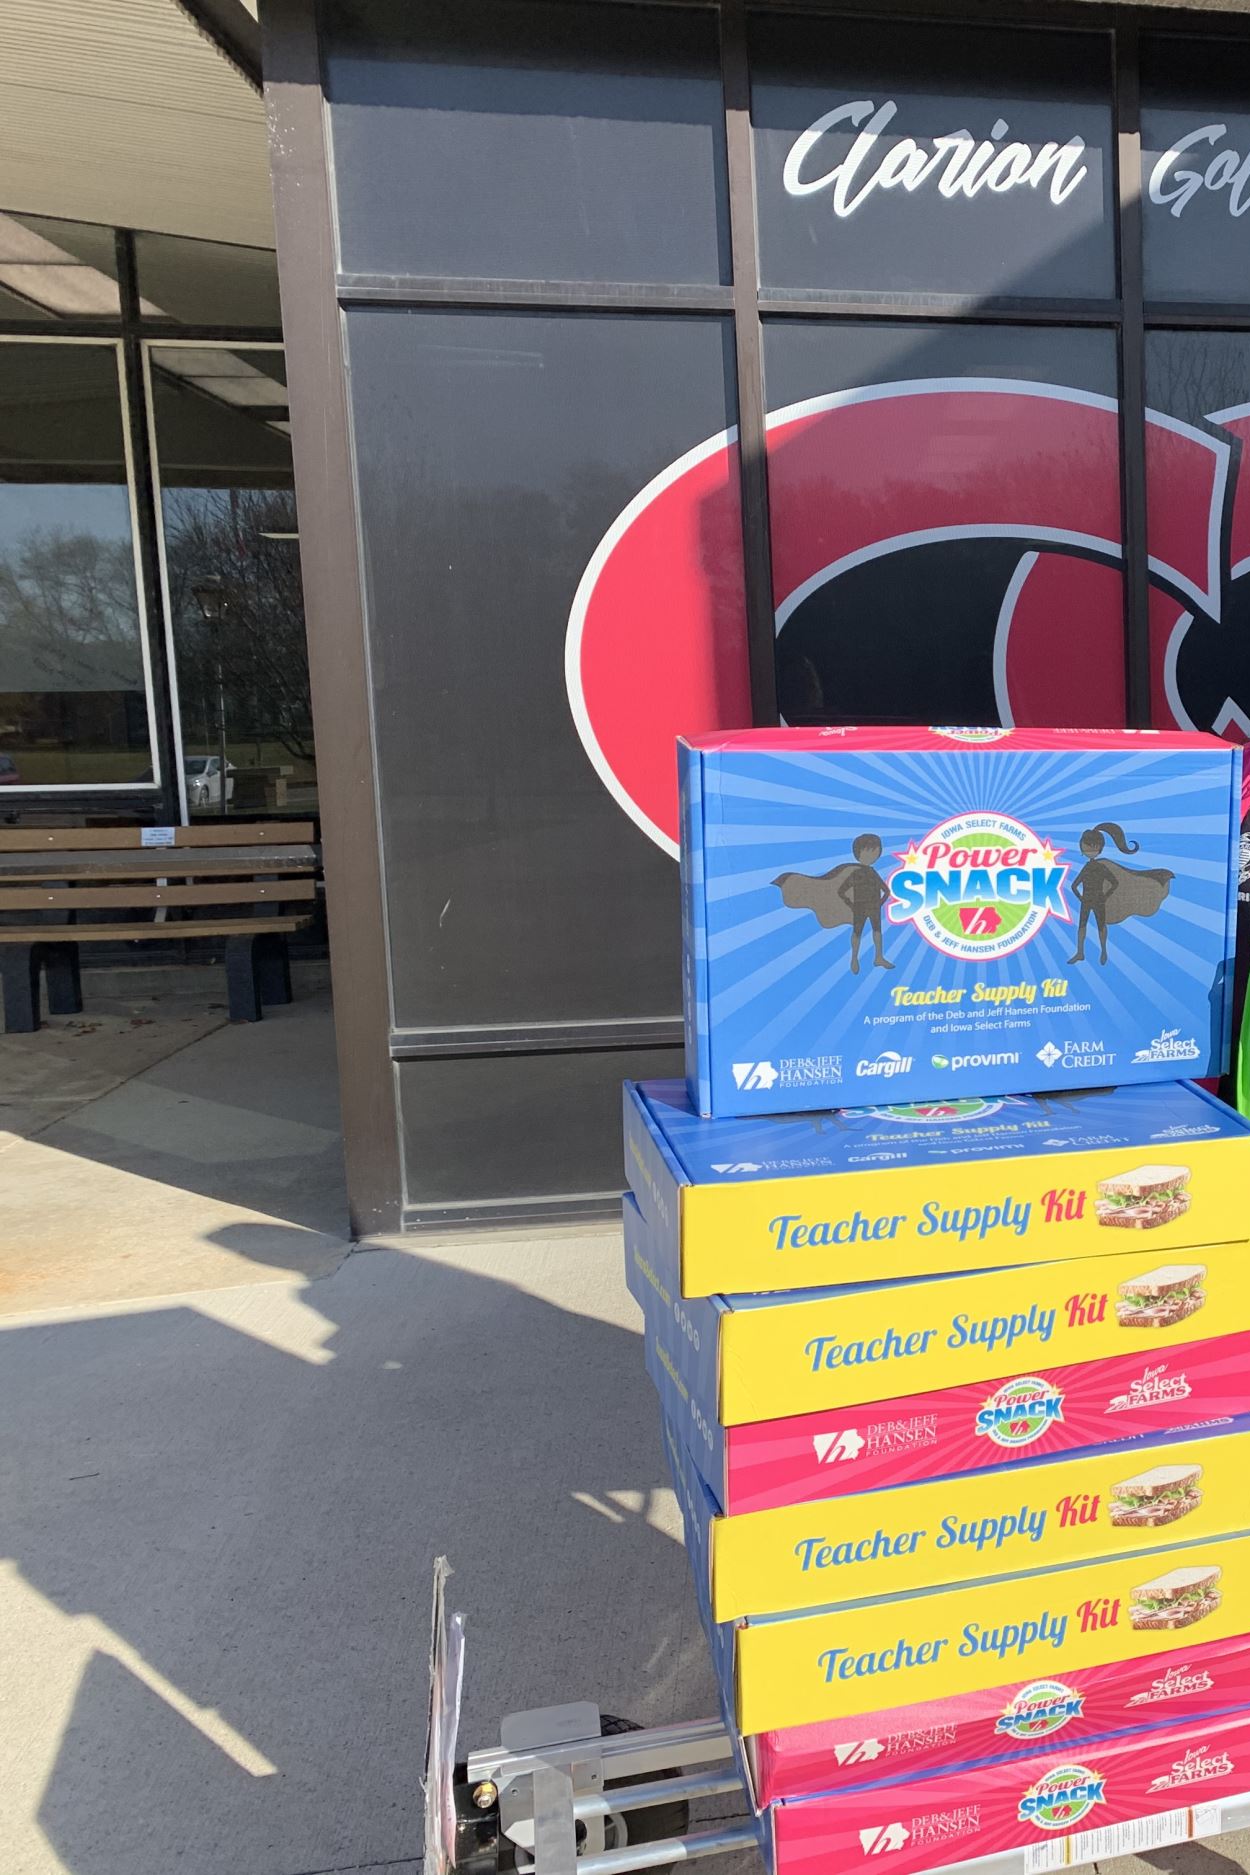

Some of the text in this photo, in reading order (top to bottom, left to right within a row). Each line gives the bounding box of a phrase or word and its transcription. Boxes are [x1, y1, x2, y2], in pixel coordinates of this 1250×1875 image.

[782, 100, 1089, 217] Clarion
[941, 819, 1027, 841] IOWA SELECT FARMS
[922, 842, 1038, 869] Power
[890, 867, 1068, 920] SNACK
[923, 914, 934, 931] DEB
[941, 936, 959, 949] JEFF
[960, 944, 996, 953] HANSEN
[997, 910, 1038, 949] FOUNDATION
[890, 977, 1069, 1007] Teacher Supply Kit
[864, 1002, 1091, 1026] A program of the Deb and Jeff Hansen Foundation
[930, 1019, 1031, 1034] and Iowa Select Farms
[1160, 1027, 1182, 1042] Iowa
[1064, 1040, 1104, 1054] FARM
[1150, 1037, 1196, 1050] Select
[1150, 1048, 1196, 1059] FARMS
[855, 1053, 913, 1079] Cargill
[951, 1051, 1020, 1071] provimi
[1061, 1053, 1116, 1069] CREDIT
[779, 1078, 843, 1088] FOUNDATION
[780, 1066, 842, 1082] HANSEN
[769, 1188, 1087, 1251] Teacher Supply Kit
[804, 1293, 1109, 1372] Teacher Supply Kit
[1130, 1373, 1187, 1394] Select
[1142, 1363, 1169, 1383] Iowa
[994, 1390, 1050, 1408] Power
[1128, 1386, 1187, 1406] FARMS
[977, 1397, 1063, 1433] SNACK
[866, 1440, 938, 1457] FOUNDATION
[867, 1426, 936, 1449] HANSEN
[794, 1494, 1101, 1571] Teacher Supply Kit
[817, 1599, 1121, 1682] Teacher Supply Kit
[1150, 1670, 1210, 1692] Select
[1150, 1680, 1209, 1700] FARMS
[1014, 1695, 1070, 1713] Power
[997, 1699, 1082, 1732] SNACK
[887, 1731, 956, 1751] HANSEN
[1170, 1751, 1229, 1775] Select
[1184, 1744, 1211, 1764] Iowa
[1170, 1763, 1229, 1785] FARMS
[1036, 1776, 1090, 1795] Power
[1020, 1781, 1104, 1820] SNACK
[912, 1815, 980, 1840] HANSEN
